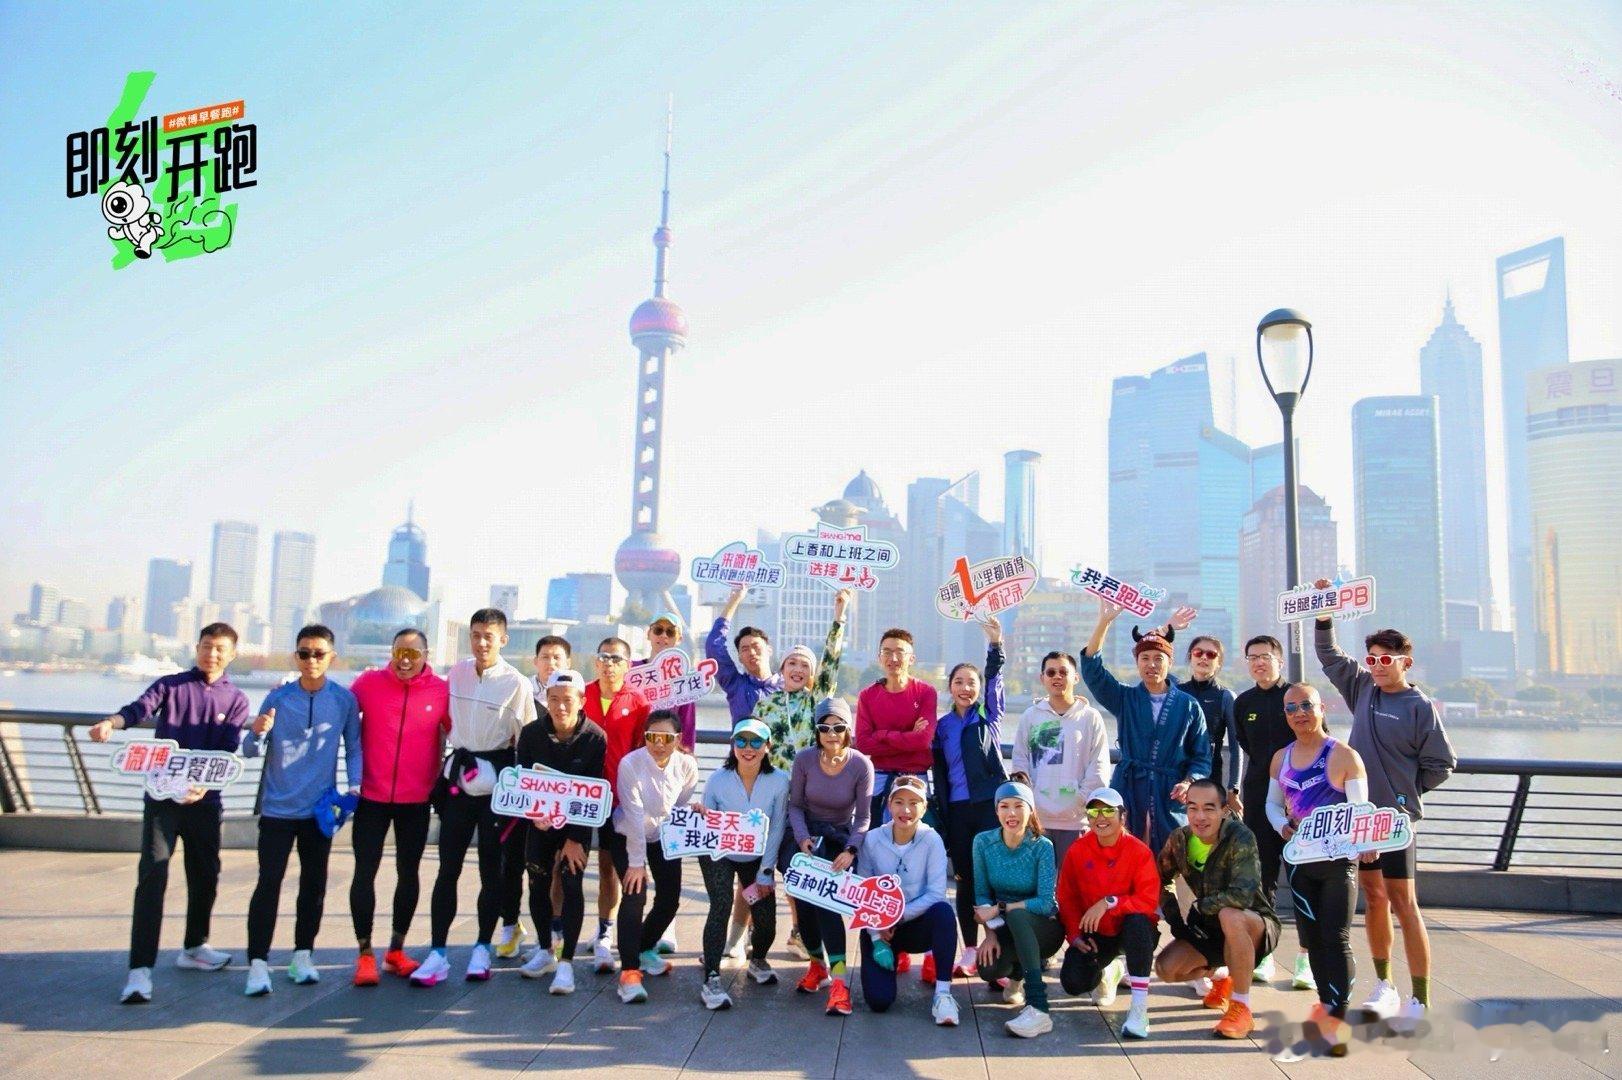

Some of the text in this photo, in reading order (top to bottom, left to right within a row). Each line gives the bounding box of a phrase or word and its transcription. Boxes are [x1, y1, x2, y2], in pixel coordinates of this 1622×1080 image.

[792, 541, 891, 562] 上香和上班之间
[987, 583, 1024, 612] 被记录
[1080, 567, 1154, 617] 我爱跑步
[1284, 585, 1368, 615] 抬腿就是PB
[670, 808, 740, 832] 这个冬天
[1301, 807, 1403, 845] #即刻开跑#
[684, 829, 755, 853] 我必变强
